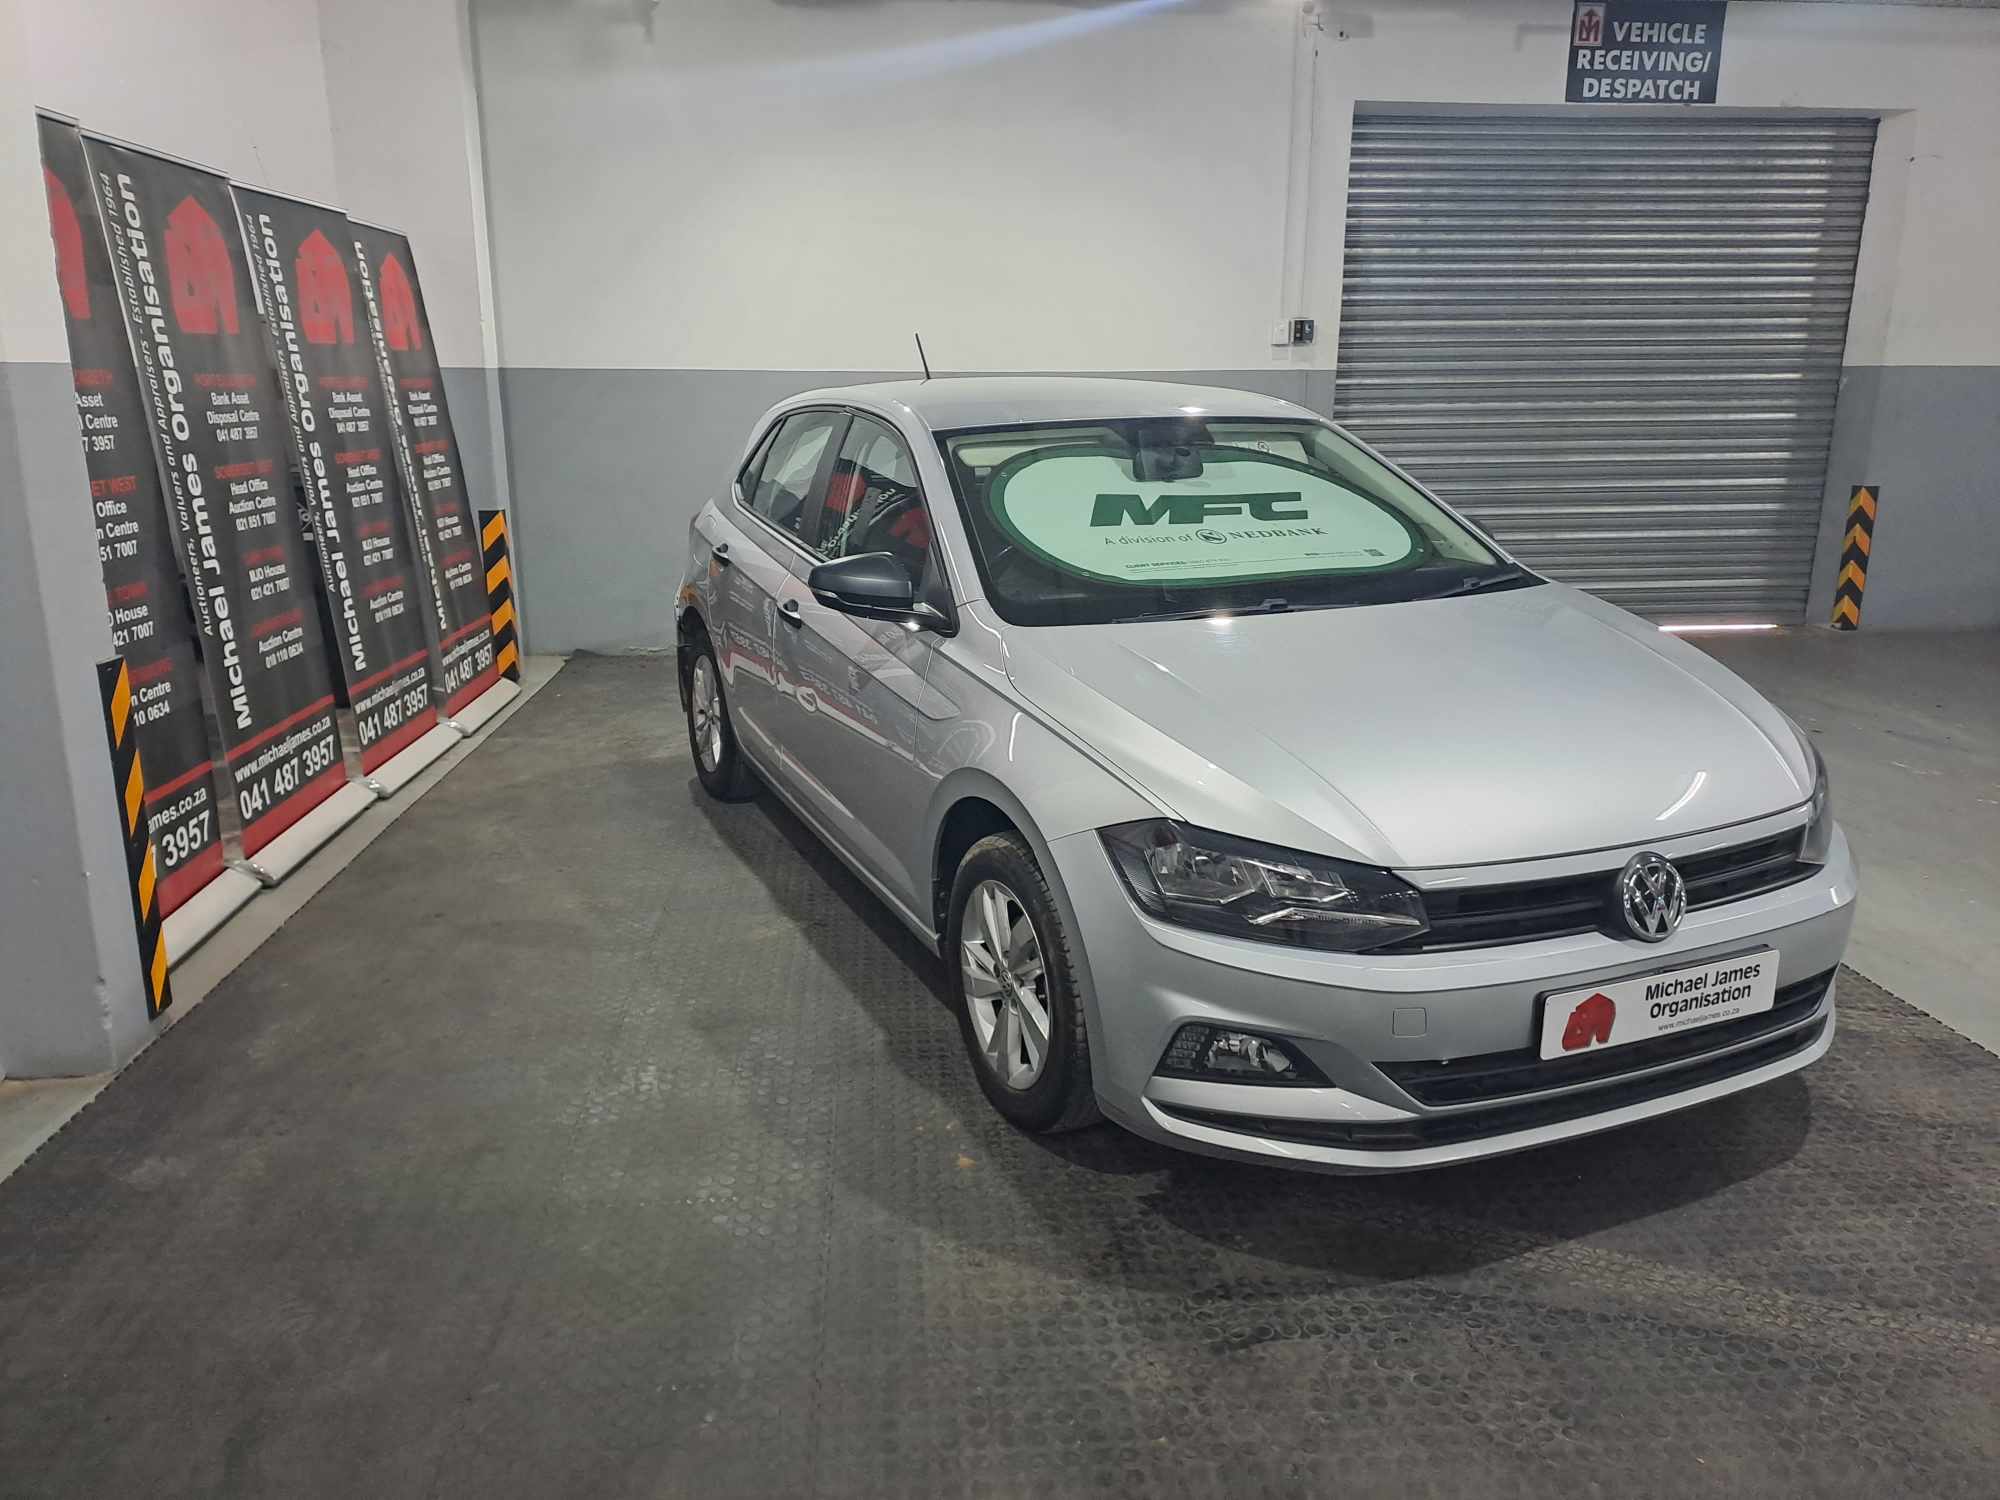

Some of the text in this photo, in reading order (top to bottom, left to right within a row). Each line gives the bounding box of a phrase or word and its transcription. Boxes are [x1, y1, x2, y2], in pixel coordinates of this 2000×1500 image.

[1612, 21, 1708, 45] VEHICLE
[1576, 49, 1712, 73] RECEIVING/
[1582, 78, 1701, 101] DESPATCH
[100, 172, 116, 217] 1964
[111, 221, 144, 324] Established
[259, 214, 316, 433] Organisation
[141, 340, 169, 429] Appraisers
[85, 413, 119, 429] Centre
[92, 434, 115, 452] 3957
[117, 173, 252, 730] Michael James Organisation
[160, 432, 176, 466] and
[96, 500, 128, 518] Office
[171, 471, 190, 532] Valuers
[309, 441, 341, 543] James
[1090, 491, 1309, 528] MFC
[105, 520, 139, 538] Centre
[1105, 527, 1329, 545] A division of NEDBANK
[114, 540, 137, 558] 7007
[115, 604, 149, 625] House
[331, 552, 366, 671] Michael
[131, 621, 154, 641] 7007
[444, 667, 460, 694] 041
[460, 656, 473, 681] 487
[475, 643, 493, 671] 3957
[140, 681, 172, 703] Centre
[148, 699, 170, 721] 0634
[359, 683, 428, 746] 041 487 3957
[240, 734, 335, 820] 041 487 3957
[161, 809, 210, 867] 3957
[1645, 964, 1760, 1001] Michael James
[1650, 985, 1751, 1018] Organisation
